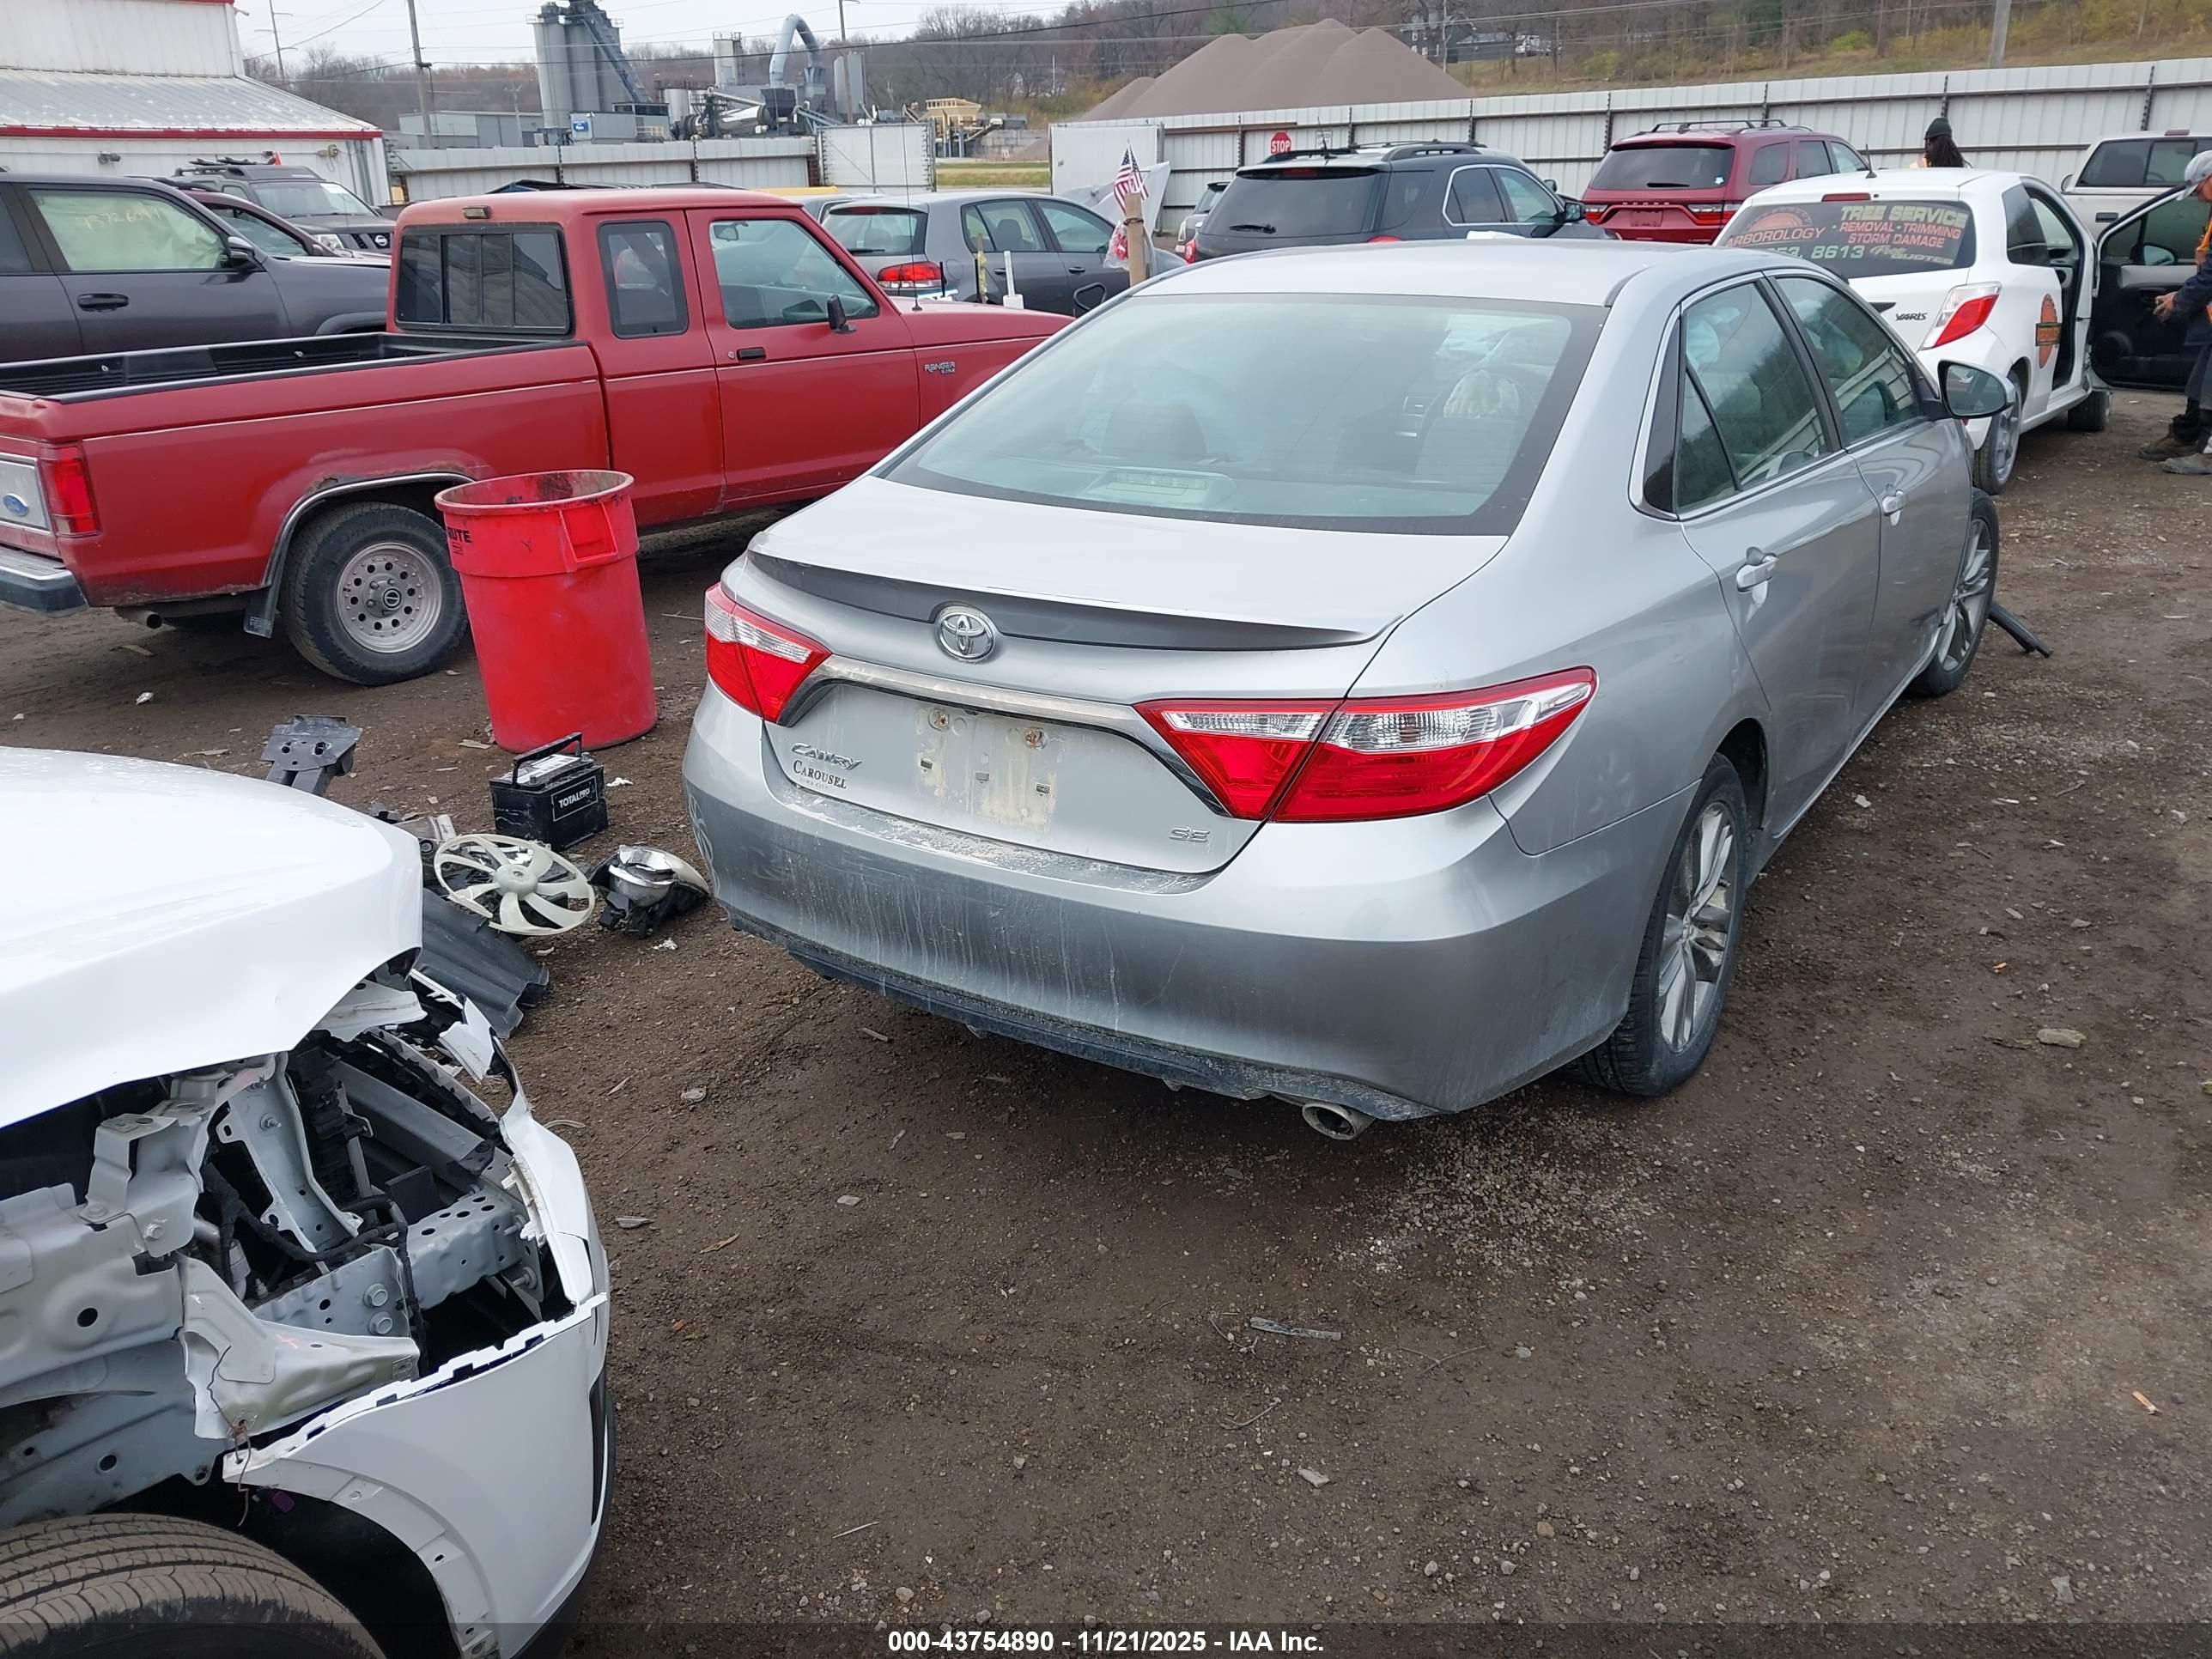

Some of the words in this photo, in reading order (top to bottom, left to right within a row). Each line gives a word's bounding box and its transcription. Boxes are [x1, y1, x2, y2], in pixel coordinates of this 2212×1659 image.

[1272, 139, 1291, 153] STOP
[1841, 205, 1887, 221] TREE
[1889, 206, 1968, 229] SERVICE
[1726, 227, 1826, 247] ARBOROLOGY
[1839, 222, 1894, 233] REMOVAL
[1903, 222, 1961, 240] TRIMMING
[1848, 233, 1890, 244] STORM
[1893, 234, 1946, 248] DAMAGE
[1811, 245, 1866, 259] 8613
[1895, 312, 1928, 321] YARIS
[924, 361, 955, 373] RANGER
[791, 742, 862, 771] CAMRY
[793, 759, 847, 789] CAROUSEL
[1169, 826, 1211, 843] SE
